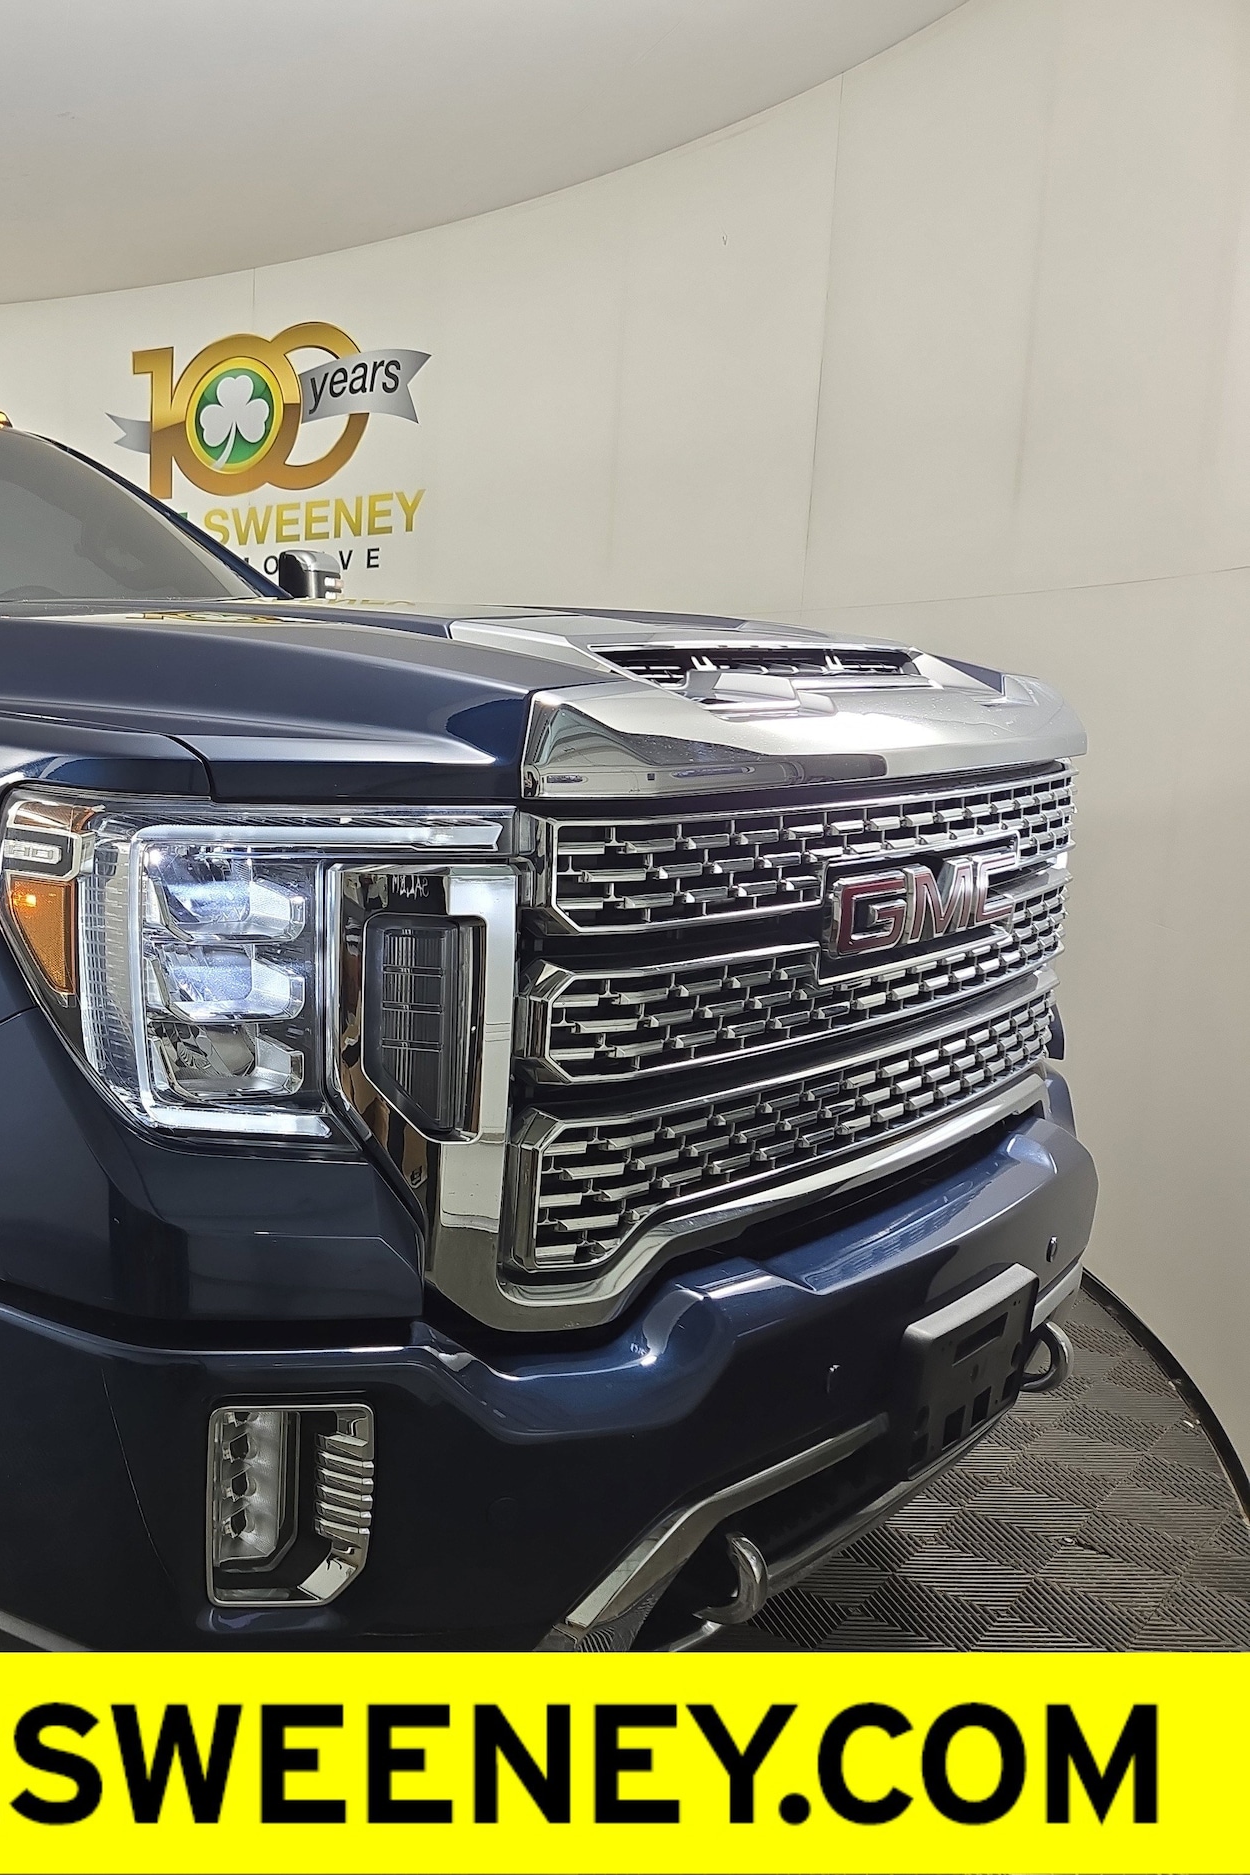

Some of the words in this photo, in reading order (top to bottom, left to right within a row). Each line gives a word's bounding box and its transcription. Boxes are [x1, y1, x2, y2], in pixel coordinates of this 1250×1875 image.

[308, 357, 401, 415] years
[203, 488, 426, 547] SWEENEY
[831, 851, 1017, 956] GMC
